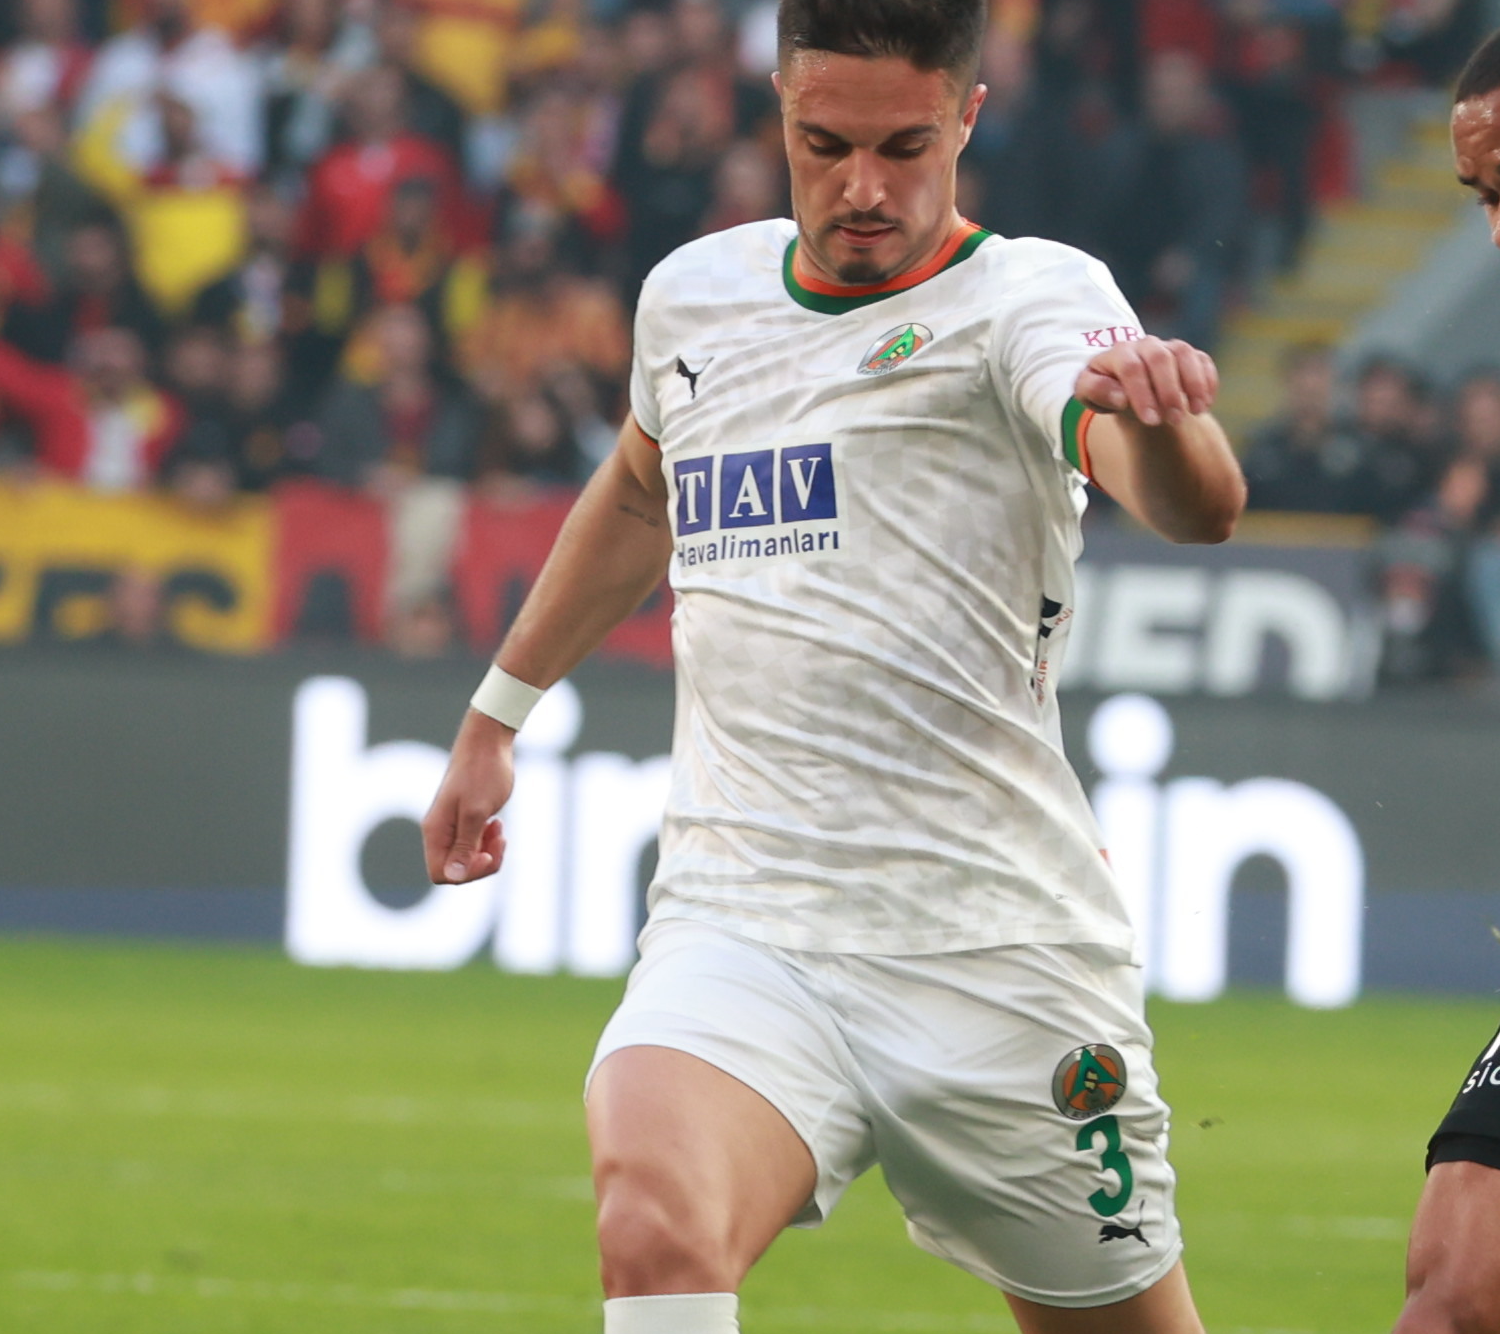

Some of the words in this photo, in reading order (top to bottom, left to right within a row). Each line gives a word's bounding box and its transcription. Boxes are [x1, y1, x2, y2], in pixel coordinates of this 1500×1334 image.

[676, 453, 826, 525] TAV
[677, 528, 840, 567] Havalimanları
[1076, 1114, 1133, 1218] 3
